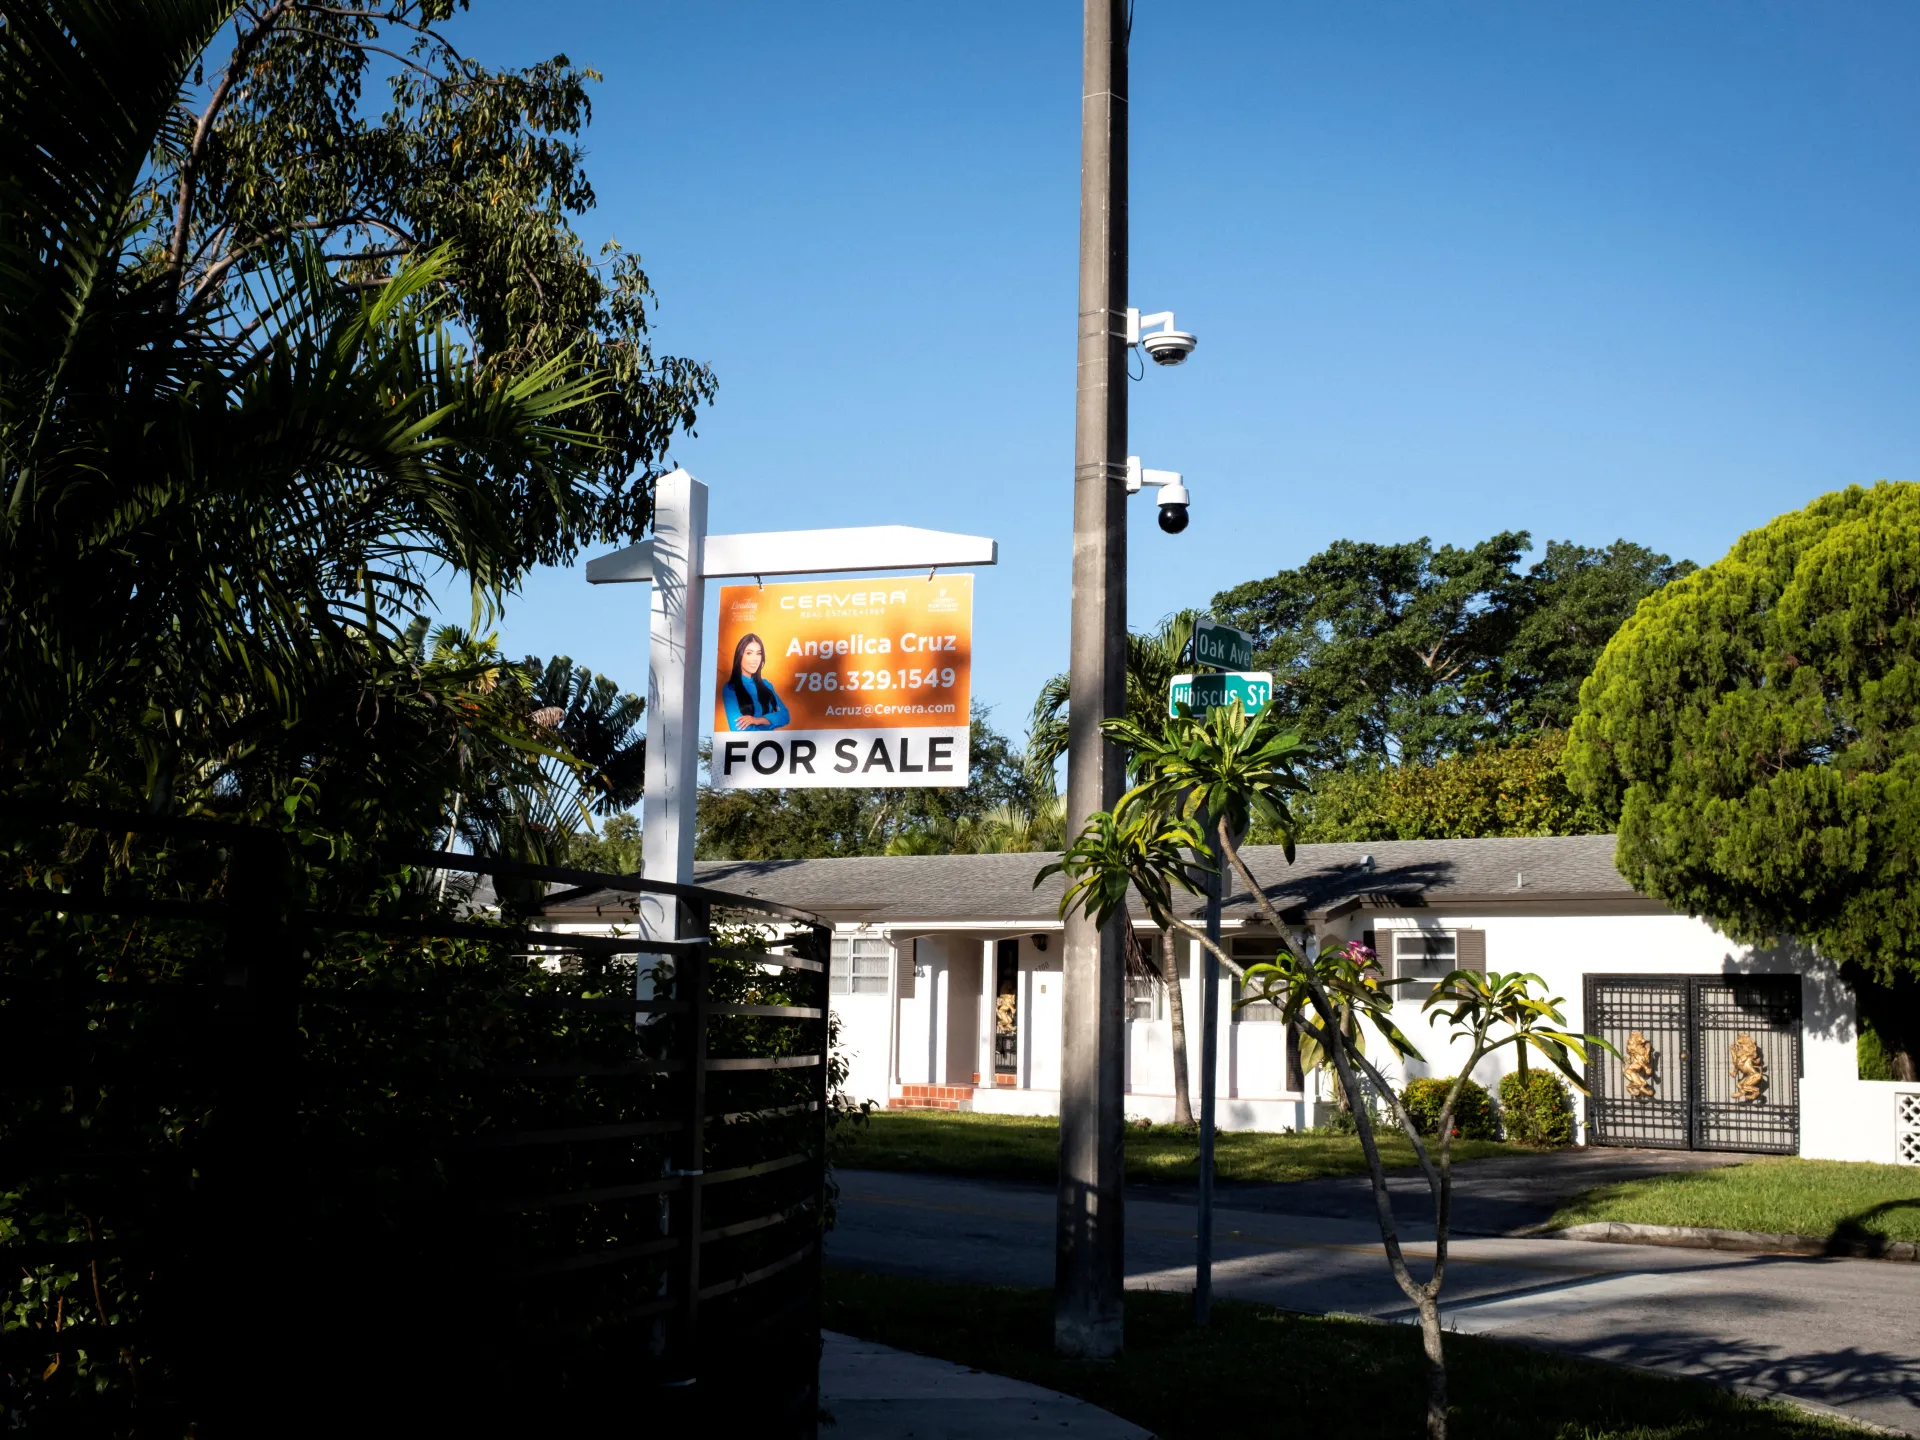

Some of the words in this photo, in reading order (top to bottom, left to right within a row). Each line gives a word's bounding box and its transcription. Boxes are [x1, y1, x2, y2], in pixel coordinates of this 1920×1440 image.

[780, 591, 906, 610] CERVERA
[800, 610, 822, 619] REAL
[786, 634, 891, 660] Angelica
[900, 632, 956, 653] Cruz
[1199, 633, 1225, 660] Oak
[1229, 642, 1250, 667] Ave
[794, 667, 956, 692] 786.329.1549
[1175, 686, 1238, 707] Hibiscus
[1247, 684, 1266, 706] St
[825, 703, 956, 717] Acruz@Cervera.com
[723, 739, 817, 776] FOR
[833, 737, 954, 774] SALE
